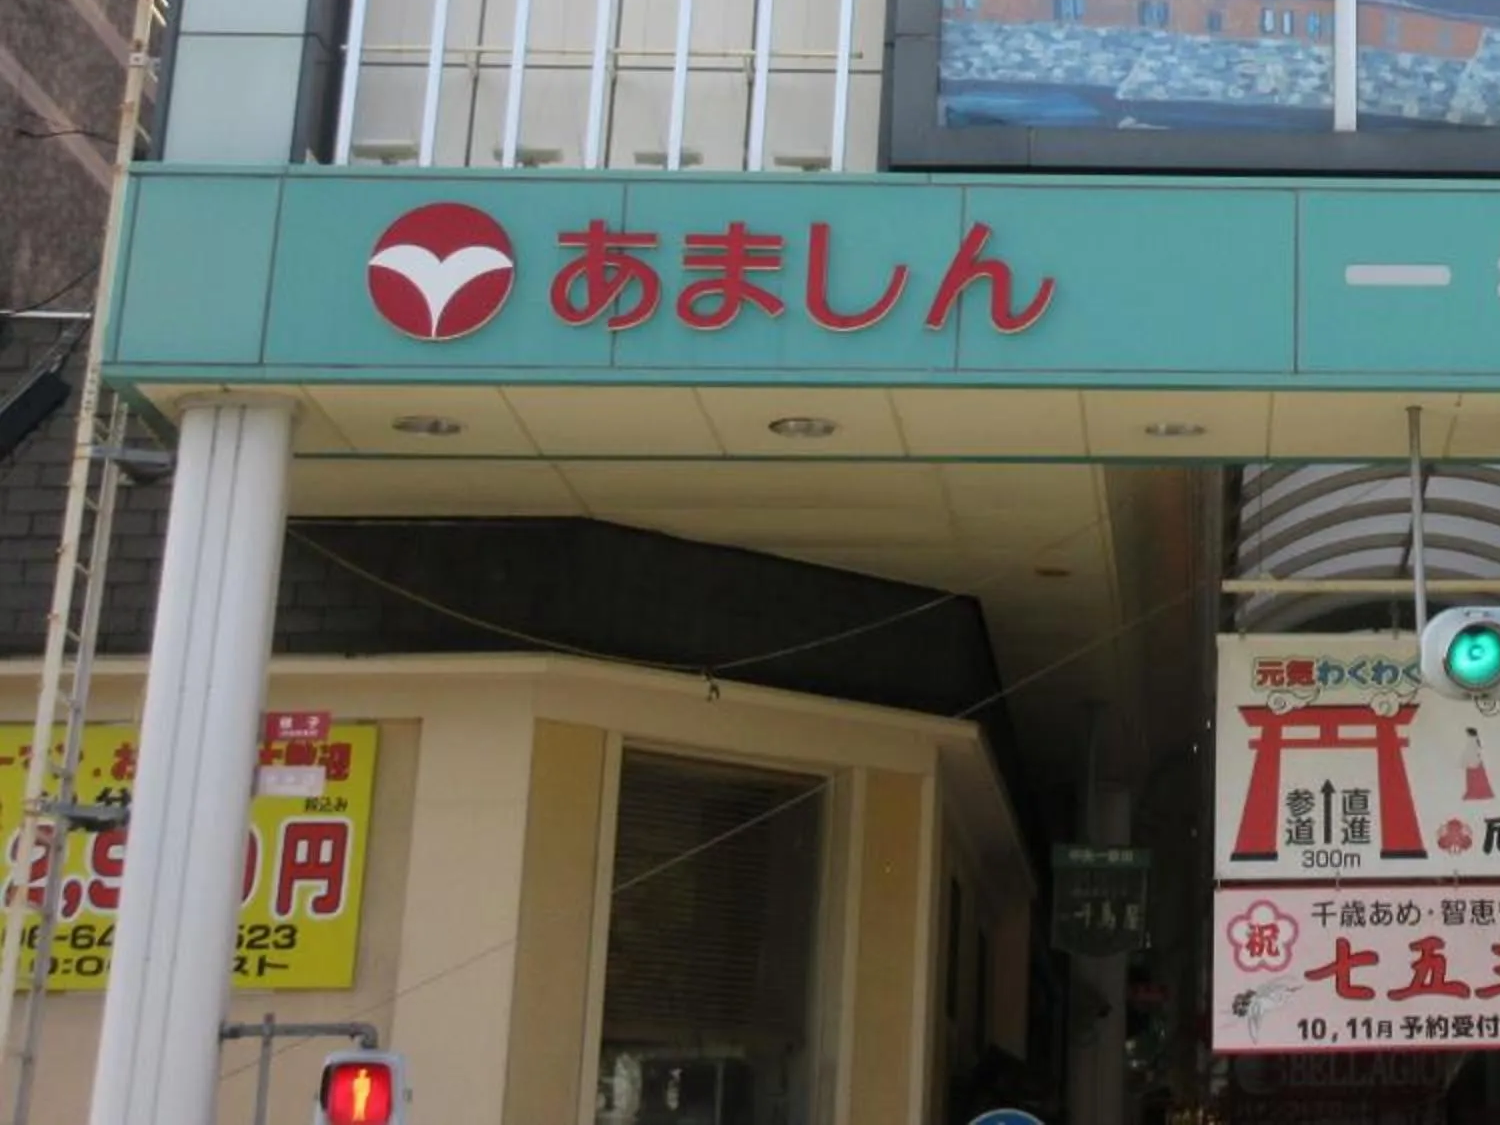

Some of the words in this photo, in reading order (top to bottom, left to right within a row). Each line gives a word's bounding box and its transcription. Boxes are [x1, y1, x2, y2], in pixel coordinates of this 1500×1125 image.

[549, 219, 1055, 333] あましん
[1285, 788, 1316, 846] 参道
[1341, 788, 1371, 846] 直進
[1301, 849, 1362, 869] 300m
[1245, 923, 1281, 958] 祝
